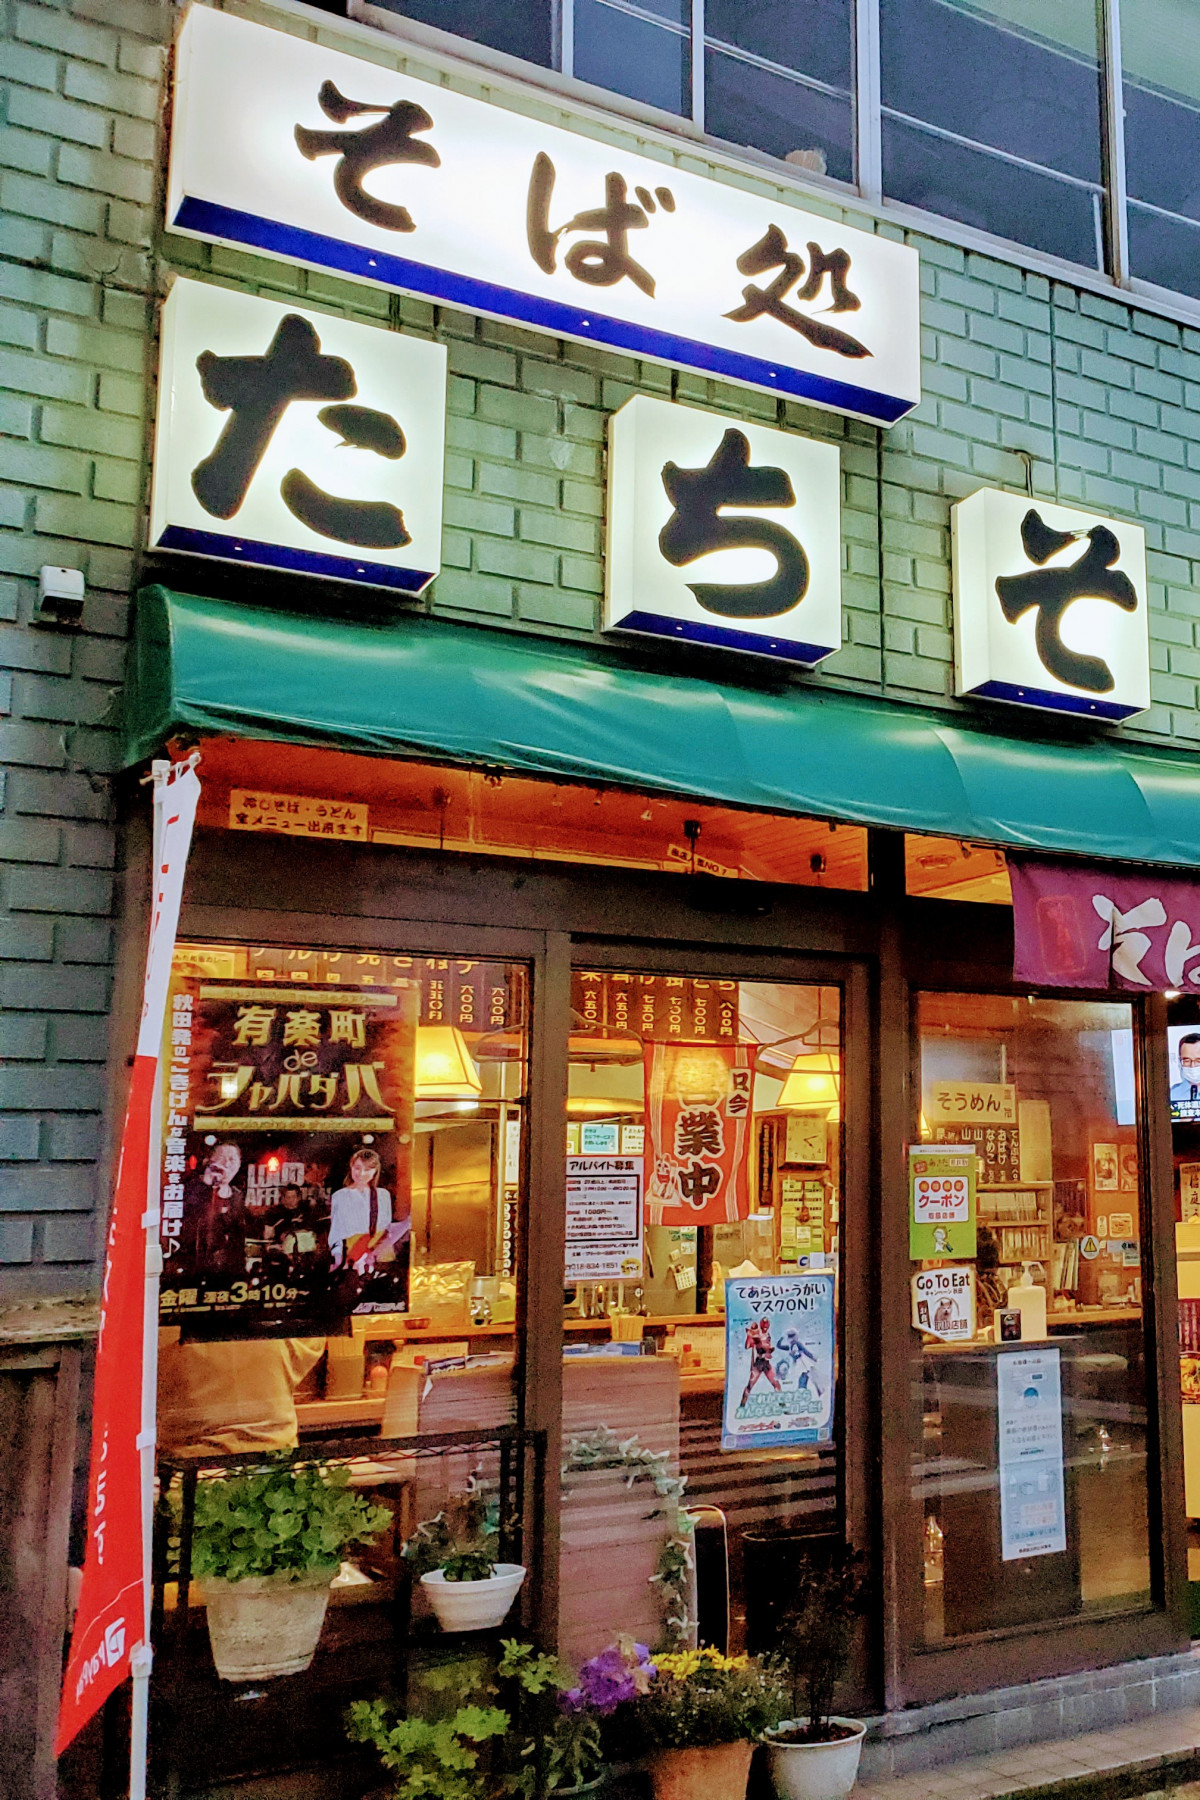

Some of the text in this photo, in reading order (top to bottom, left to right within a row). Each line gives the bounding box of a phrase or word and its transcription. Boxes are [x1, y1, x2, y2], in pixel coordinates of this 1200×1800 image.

[295, 79, 873, 359] そば処
[231, 1005, 366, 1048] 有楽町
[284, 1049, 318, 1072] de
[937, 1092, 1001, 1112] そうめん
[678, 1085, 722, 1207] 業中
[918, 1193, 965, 1209] クーポン
[916, 1272, 970, 1290] Go To Eat
